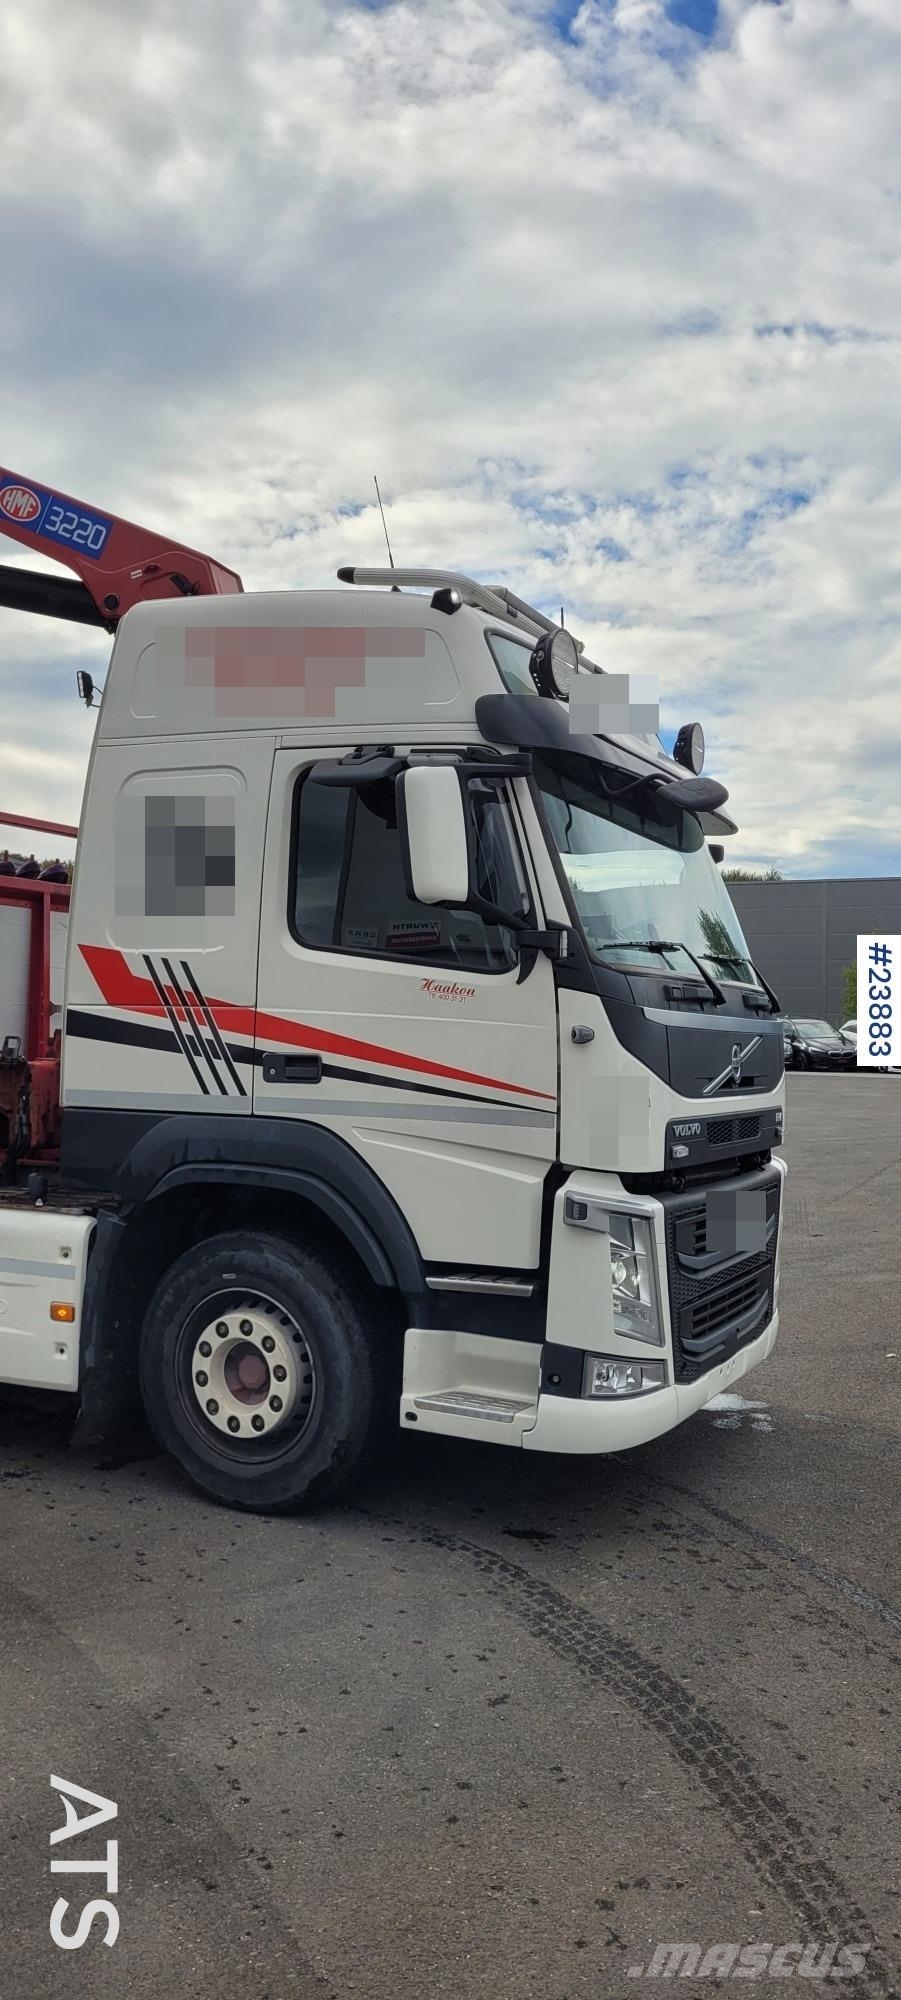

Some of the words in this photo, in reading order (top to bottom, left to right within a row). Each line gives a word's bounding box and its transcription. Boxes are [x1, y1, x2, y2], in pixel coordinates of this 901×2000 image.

[3, 489, 37, 518] HMF
[45, 505, 107, 550] 3220
[420, 978, 477, 998] Haakon
[672, 1122, 701, 1138] VOLVO
